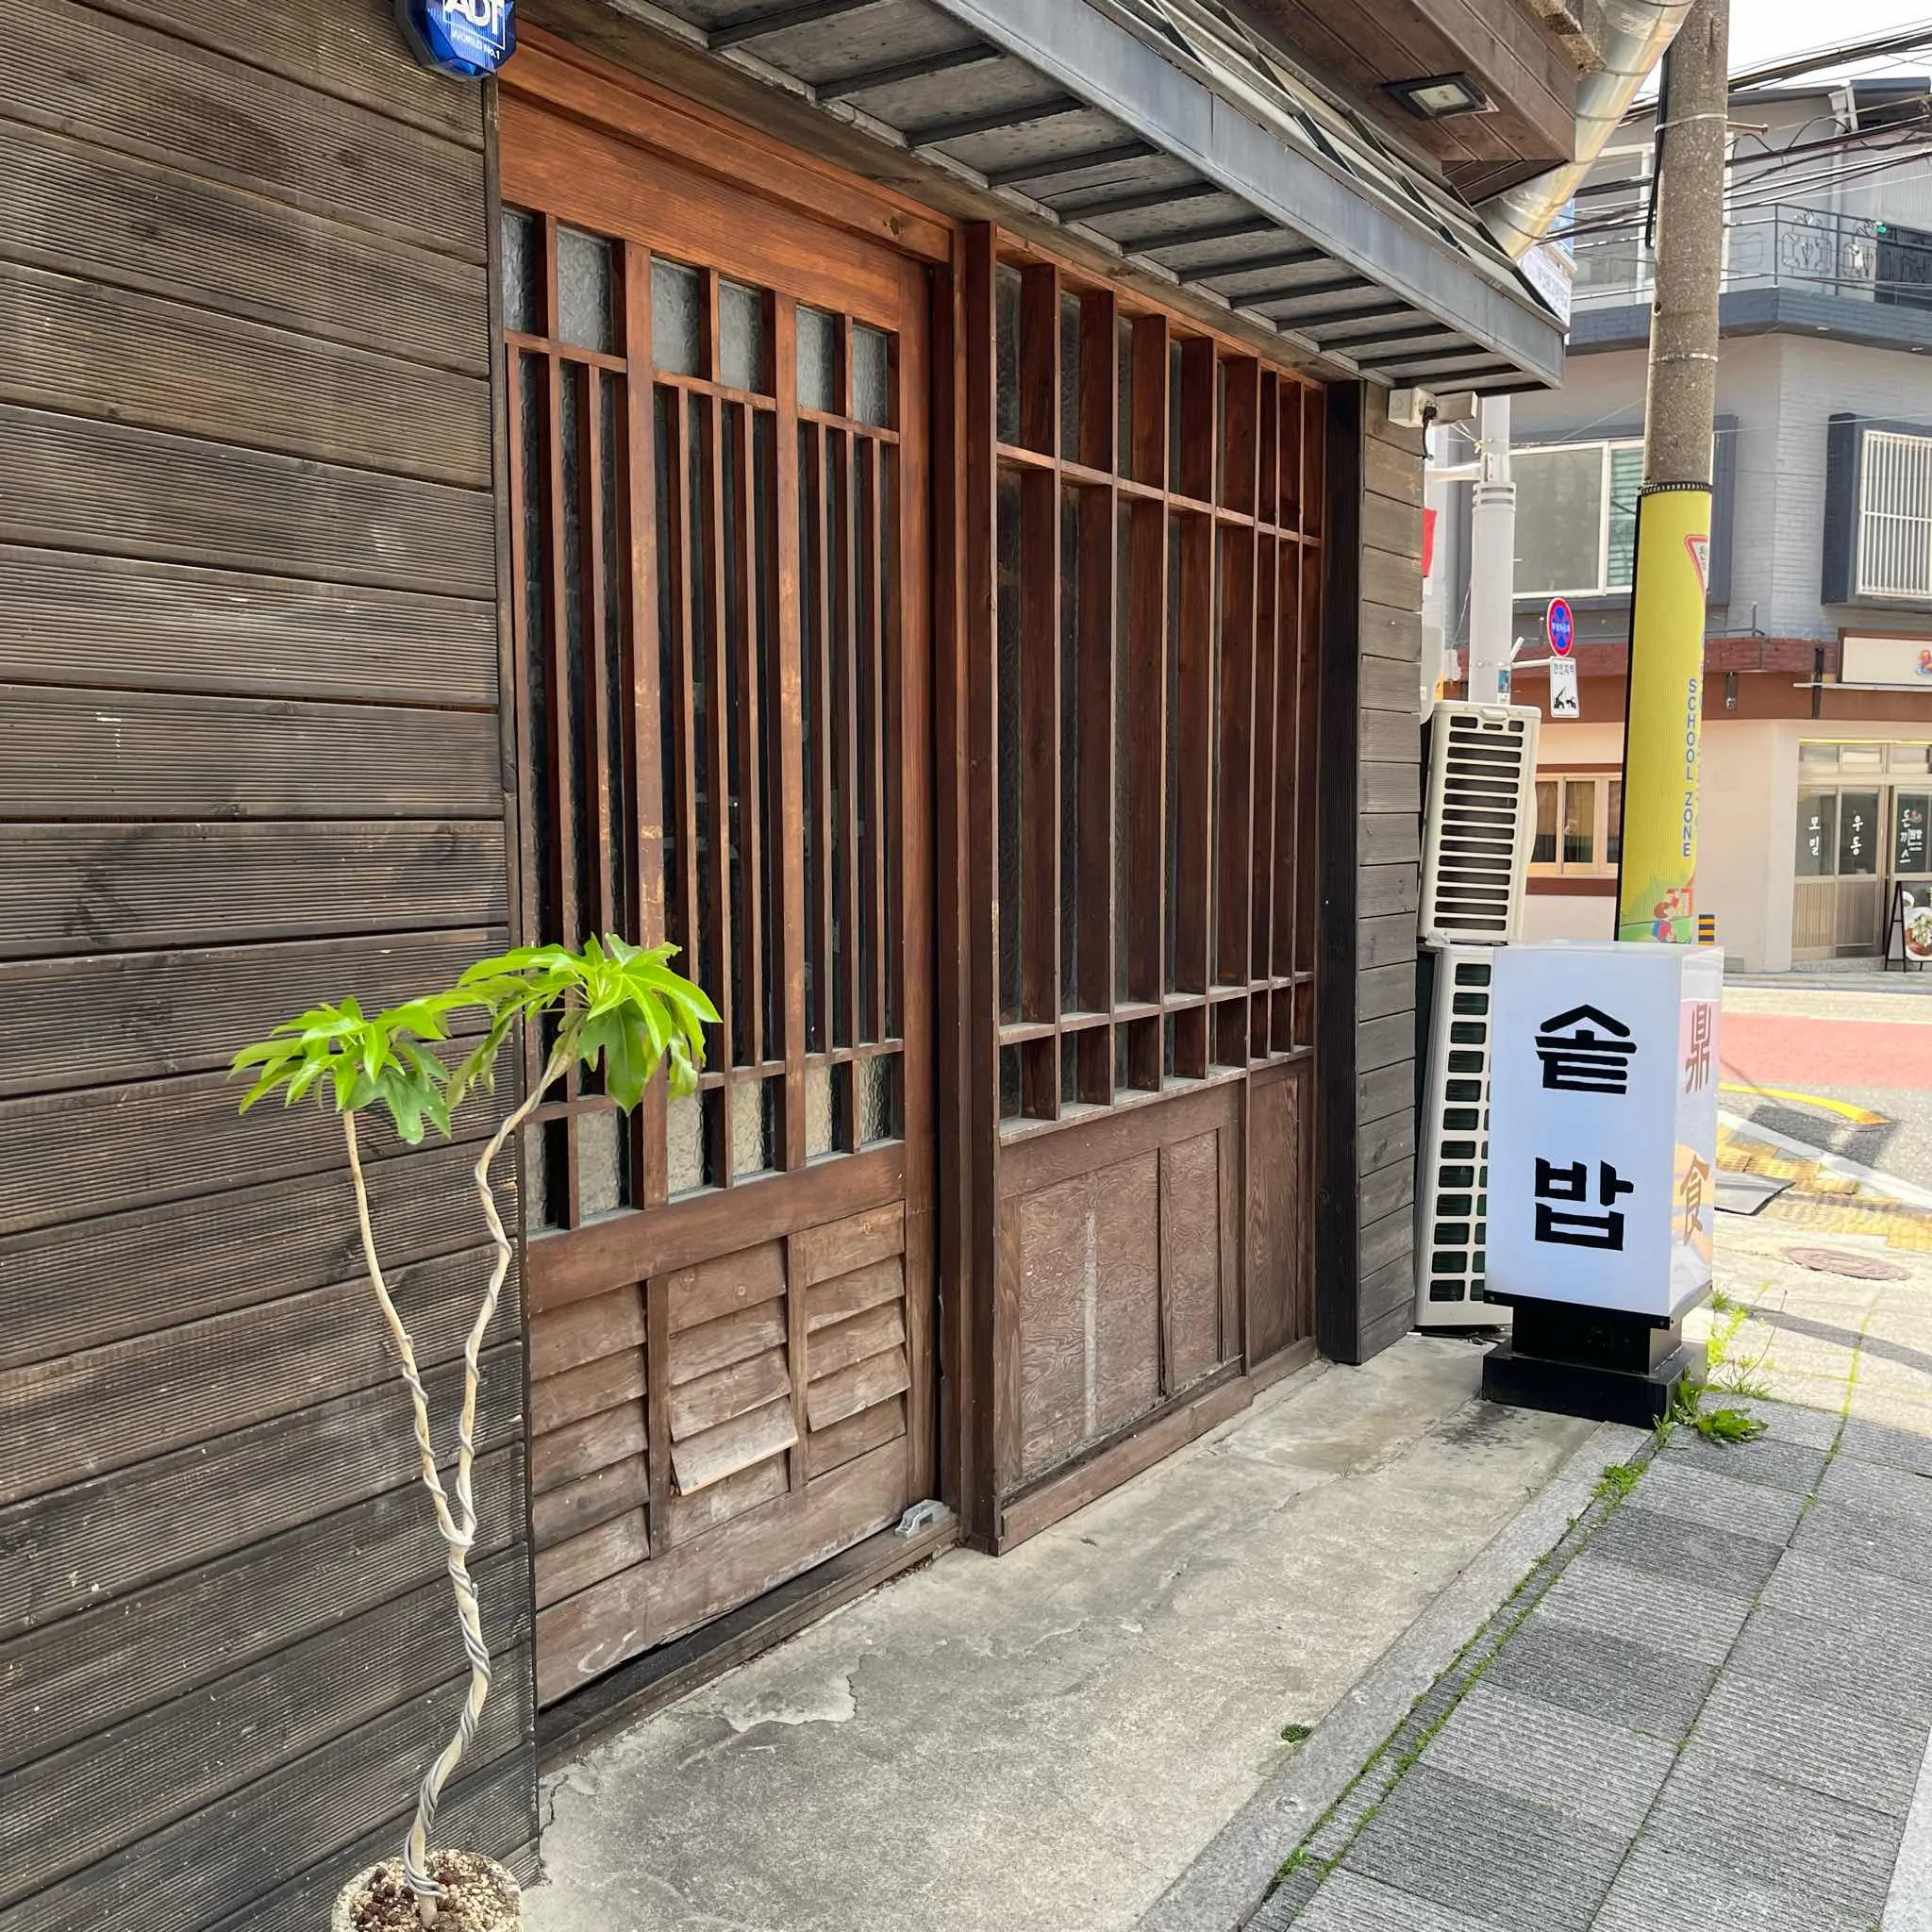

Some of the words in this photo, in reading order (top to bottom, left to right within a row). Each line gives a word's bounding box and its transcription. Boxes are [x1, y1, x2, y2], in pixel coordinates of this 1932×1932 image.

[1686, 678, 1697, 781] SCHOOL
[1683, 791, 1693, 858] ZONE
[1850, 815, 1864, 856] 우동
[1535, 1004, 1638, 1251] 솥밥
